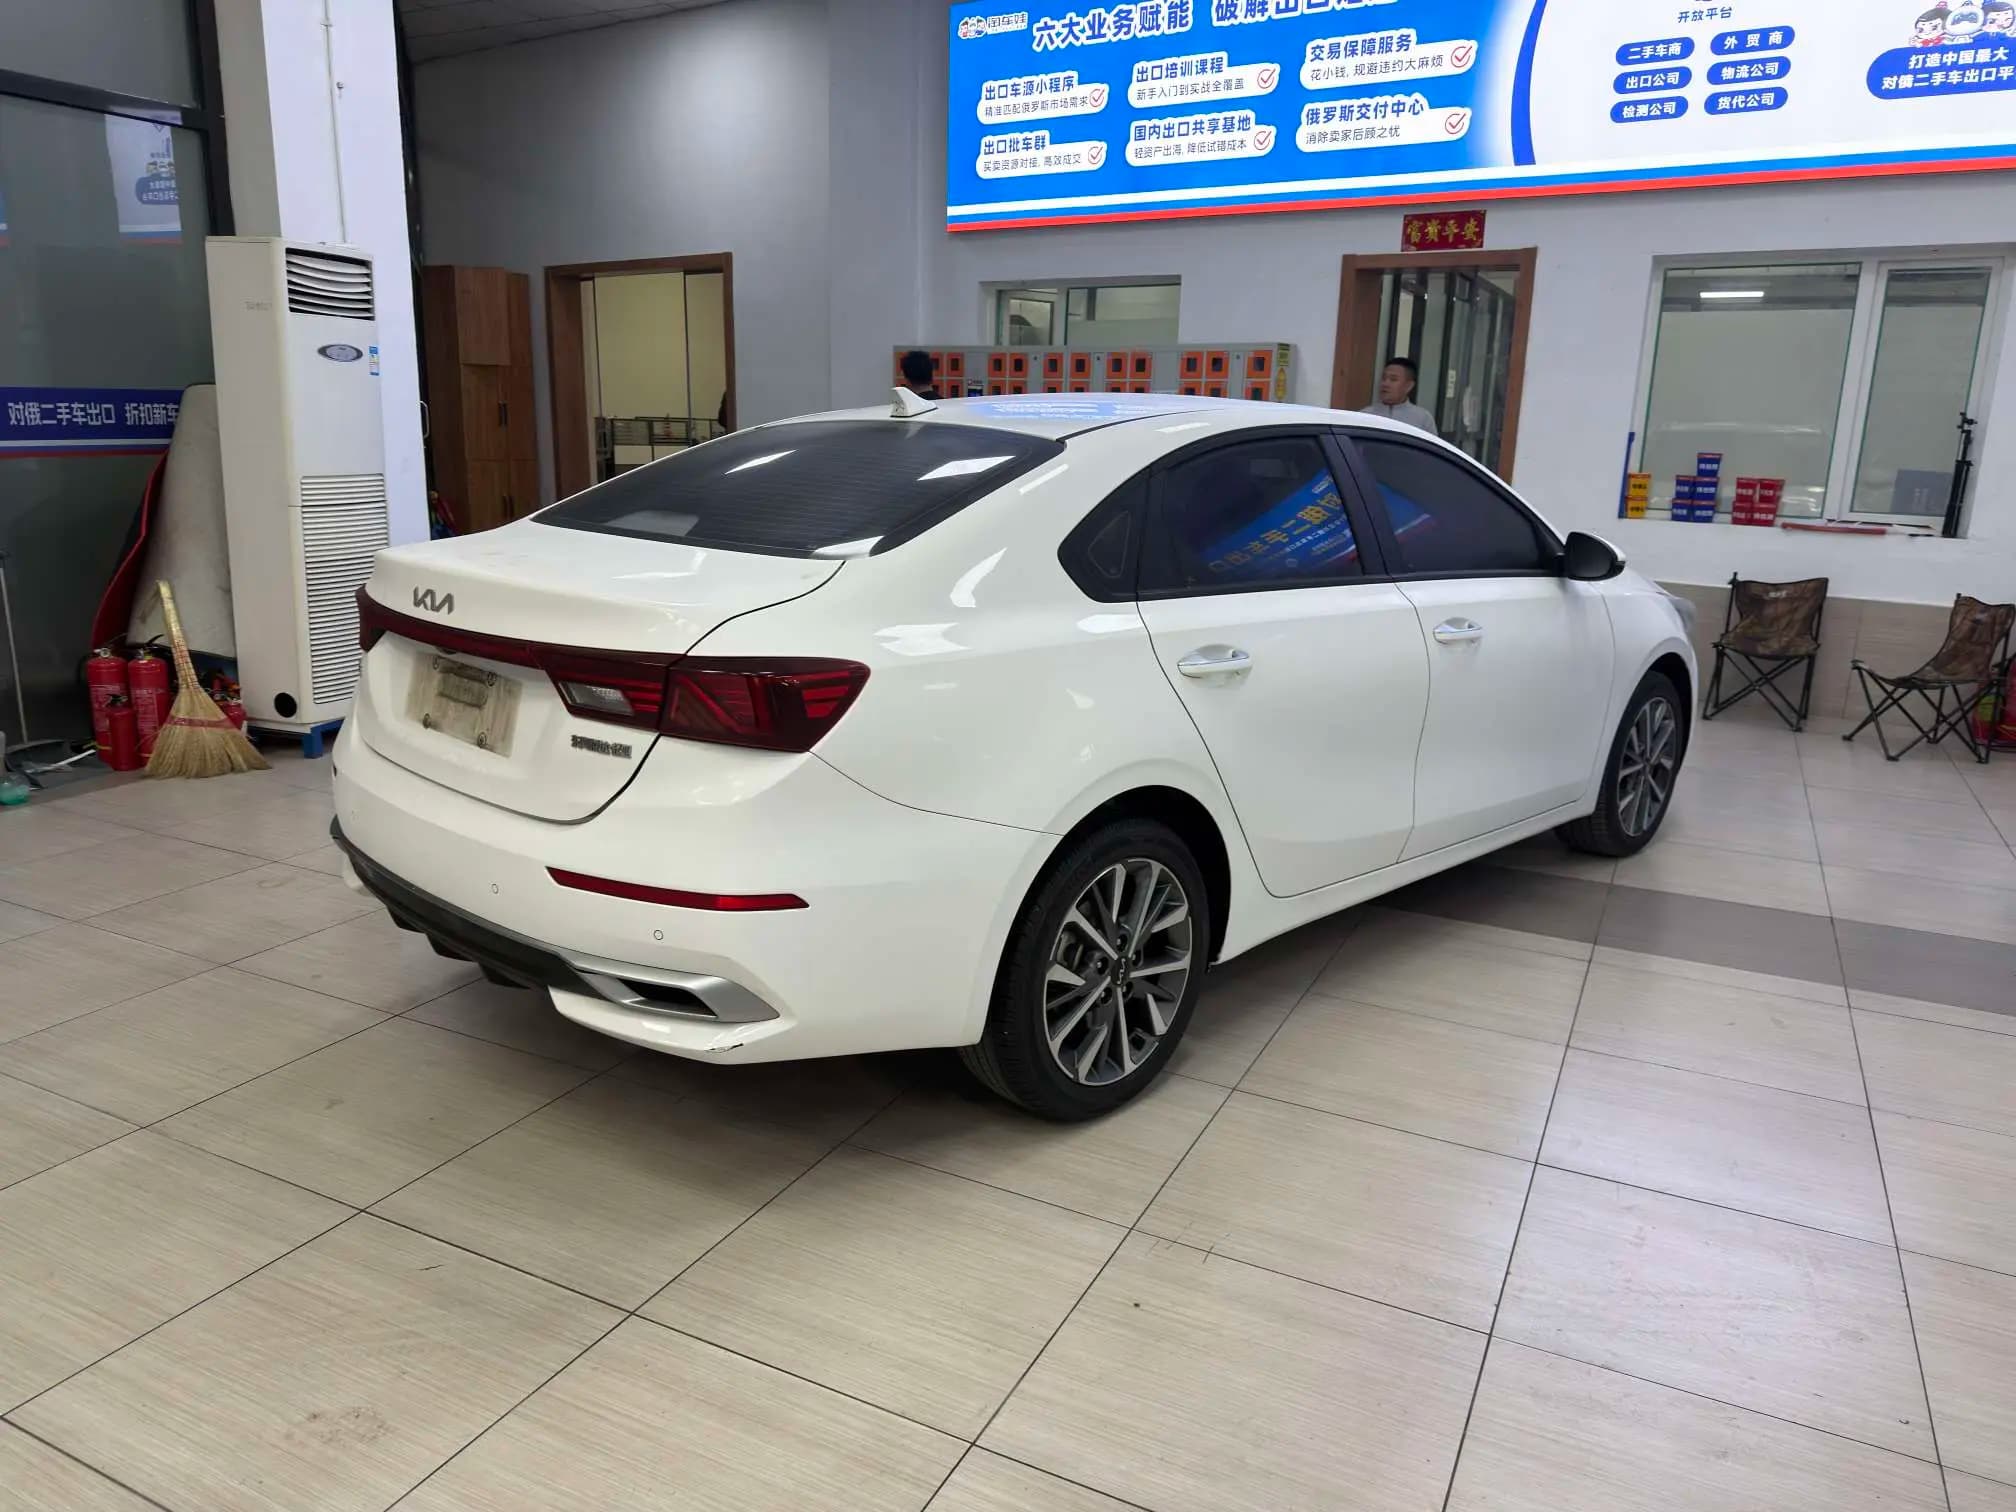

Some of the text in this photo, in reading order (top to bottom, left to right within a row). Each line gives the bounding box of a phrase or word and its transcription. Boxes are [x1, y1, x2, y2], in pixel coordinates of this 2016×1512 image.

[1036, 0, 1191, 48] 六大业务赋能
[1677, 6, 1733, 23] 开放平台
[1310, 33, 1412, 62] 交易保障服务
[1627, 42, 1682, 60] 二手车商
[1723, 31, 1784, 50] 外贸商
[1136, 56, 1224, 83] 出口培训课程
[1908, 46, 2009, 70] 打造中国最大
[1625, 72, 1680, 89] 出口公司
[1721, 62, 1779, 80] 物流公司
[1881, 65, 2016, 90] 对俄二手车出口平
[985, 75, 1074, 101] 出口车源小程序
[1306, 98, 1424, 126] 俄罗斯交付中心
[1622, 101, 1677, 119] 检测公司
[1716, 92, 1775, 111] 货代公司
[1134, 114, 1251, 142] 国内出口共享基地
[983, 135, 1046, 155] 出口批车群
[8, 402, 115, 425] 对俄二手车出口
[413, 586, 454, 615] KIA
